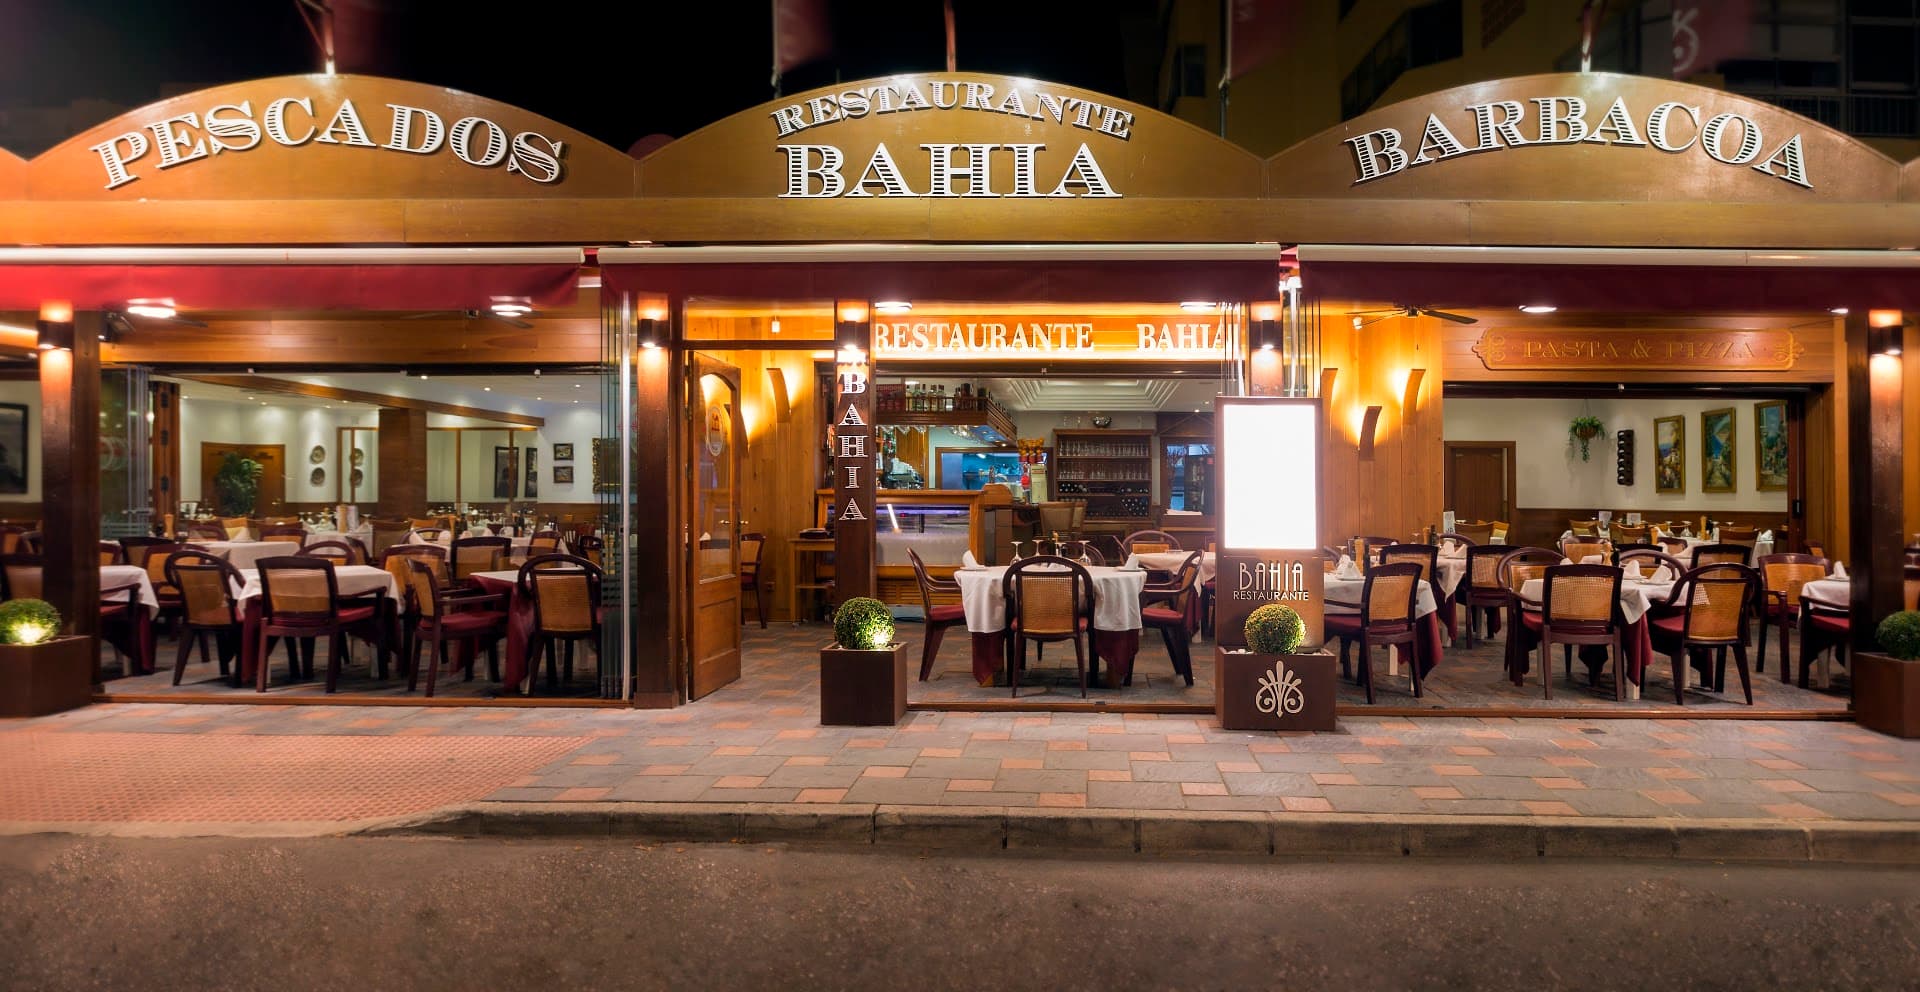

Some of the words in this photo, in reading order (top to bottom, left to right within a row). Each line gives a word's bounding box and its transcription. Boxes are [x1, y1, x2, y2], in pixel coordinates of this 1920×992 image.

[770, 81, 1135, 141] RESTAURANTE
[89, 96, 564, 191] PESCADOS
[777, 142, 1123, 199] BAHIA
[1344, 95, 1815, 189] BARBACOA
[875, 322, 1095, 351] RESTAURANTE
[1523, 340, 1620, 359] PASTA
[1629, 338, 1654, 360] &
[1665, 340, 1757, 360] PIZZA
[837, 371, 870, 521] BAHIA
[1233, 590, 1310, 601] RESTAURANTE
[1239, 562, 1304, 592] BAHIA
